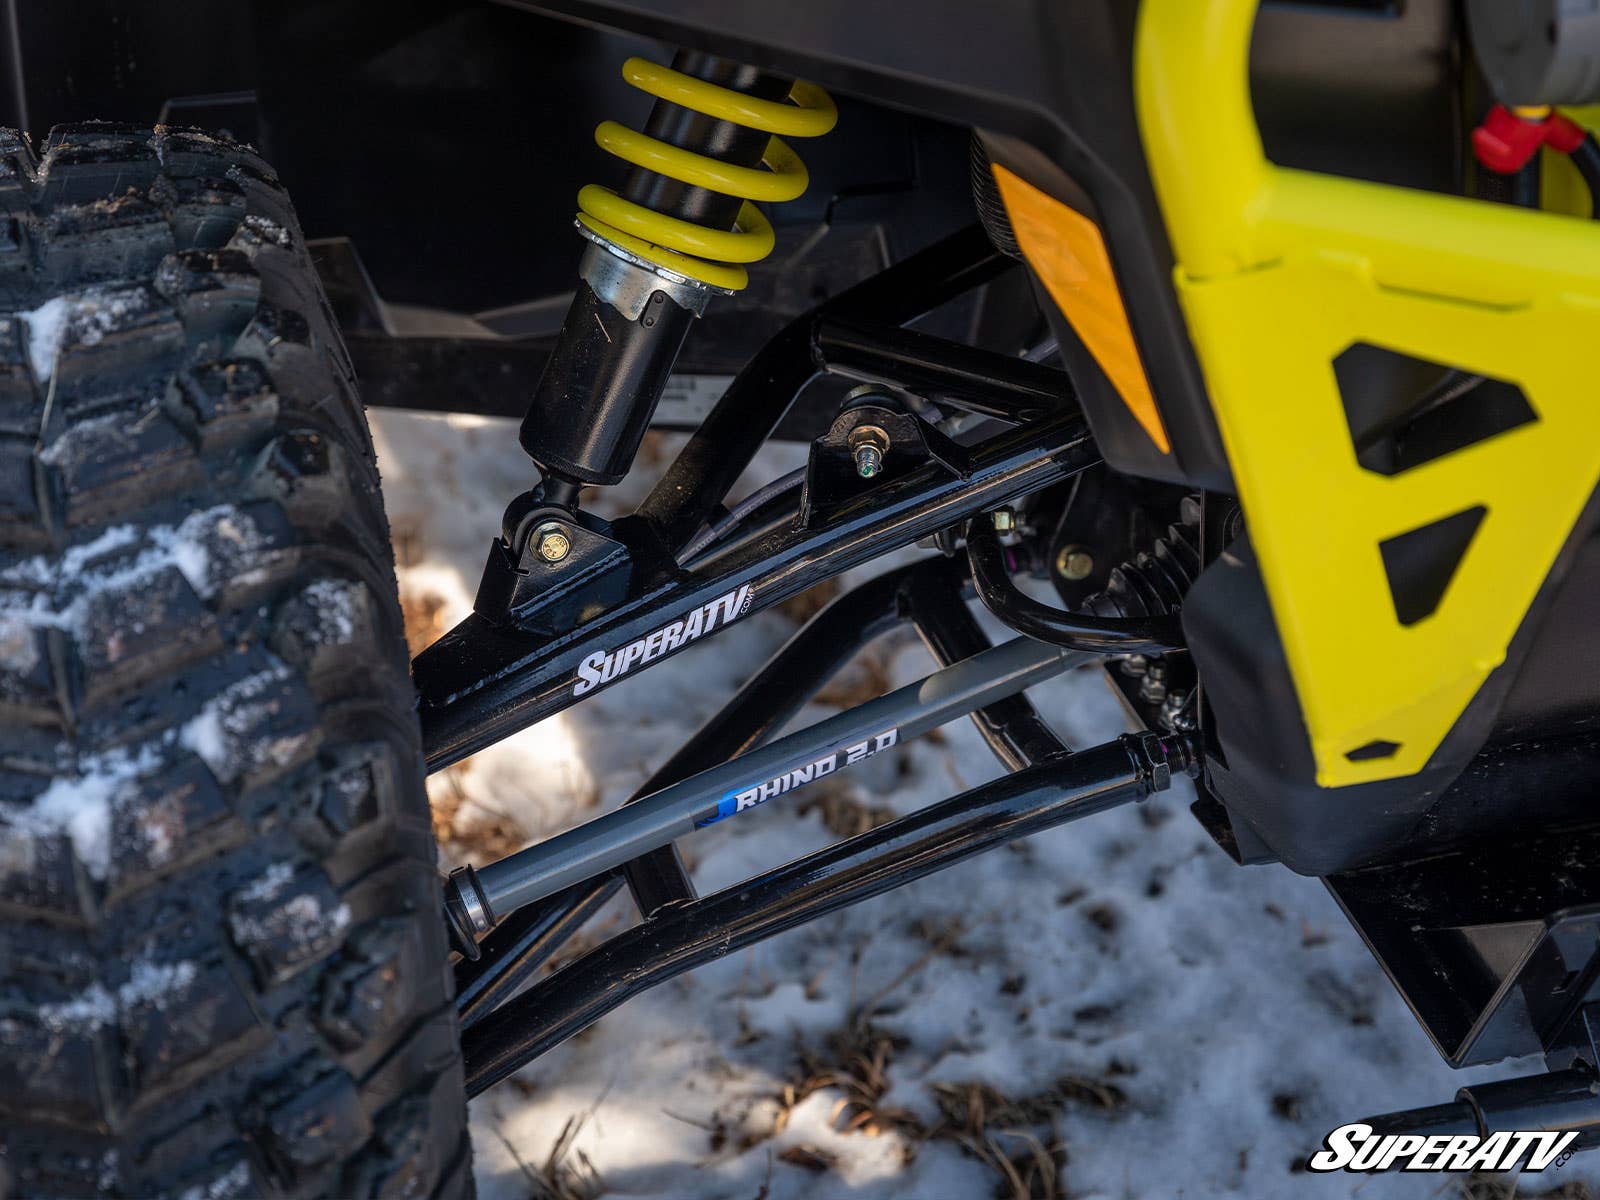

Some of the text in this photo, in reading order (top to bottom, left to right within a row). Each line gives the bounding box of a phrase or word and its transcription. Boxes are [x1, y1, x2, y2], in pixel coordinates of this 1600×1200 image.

[573, 584, 750, 696] SUPERATV
[735, 727, 898, 812] RHINO 2.0
